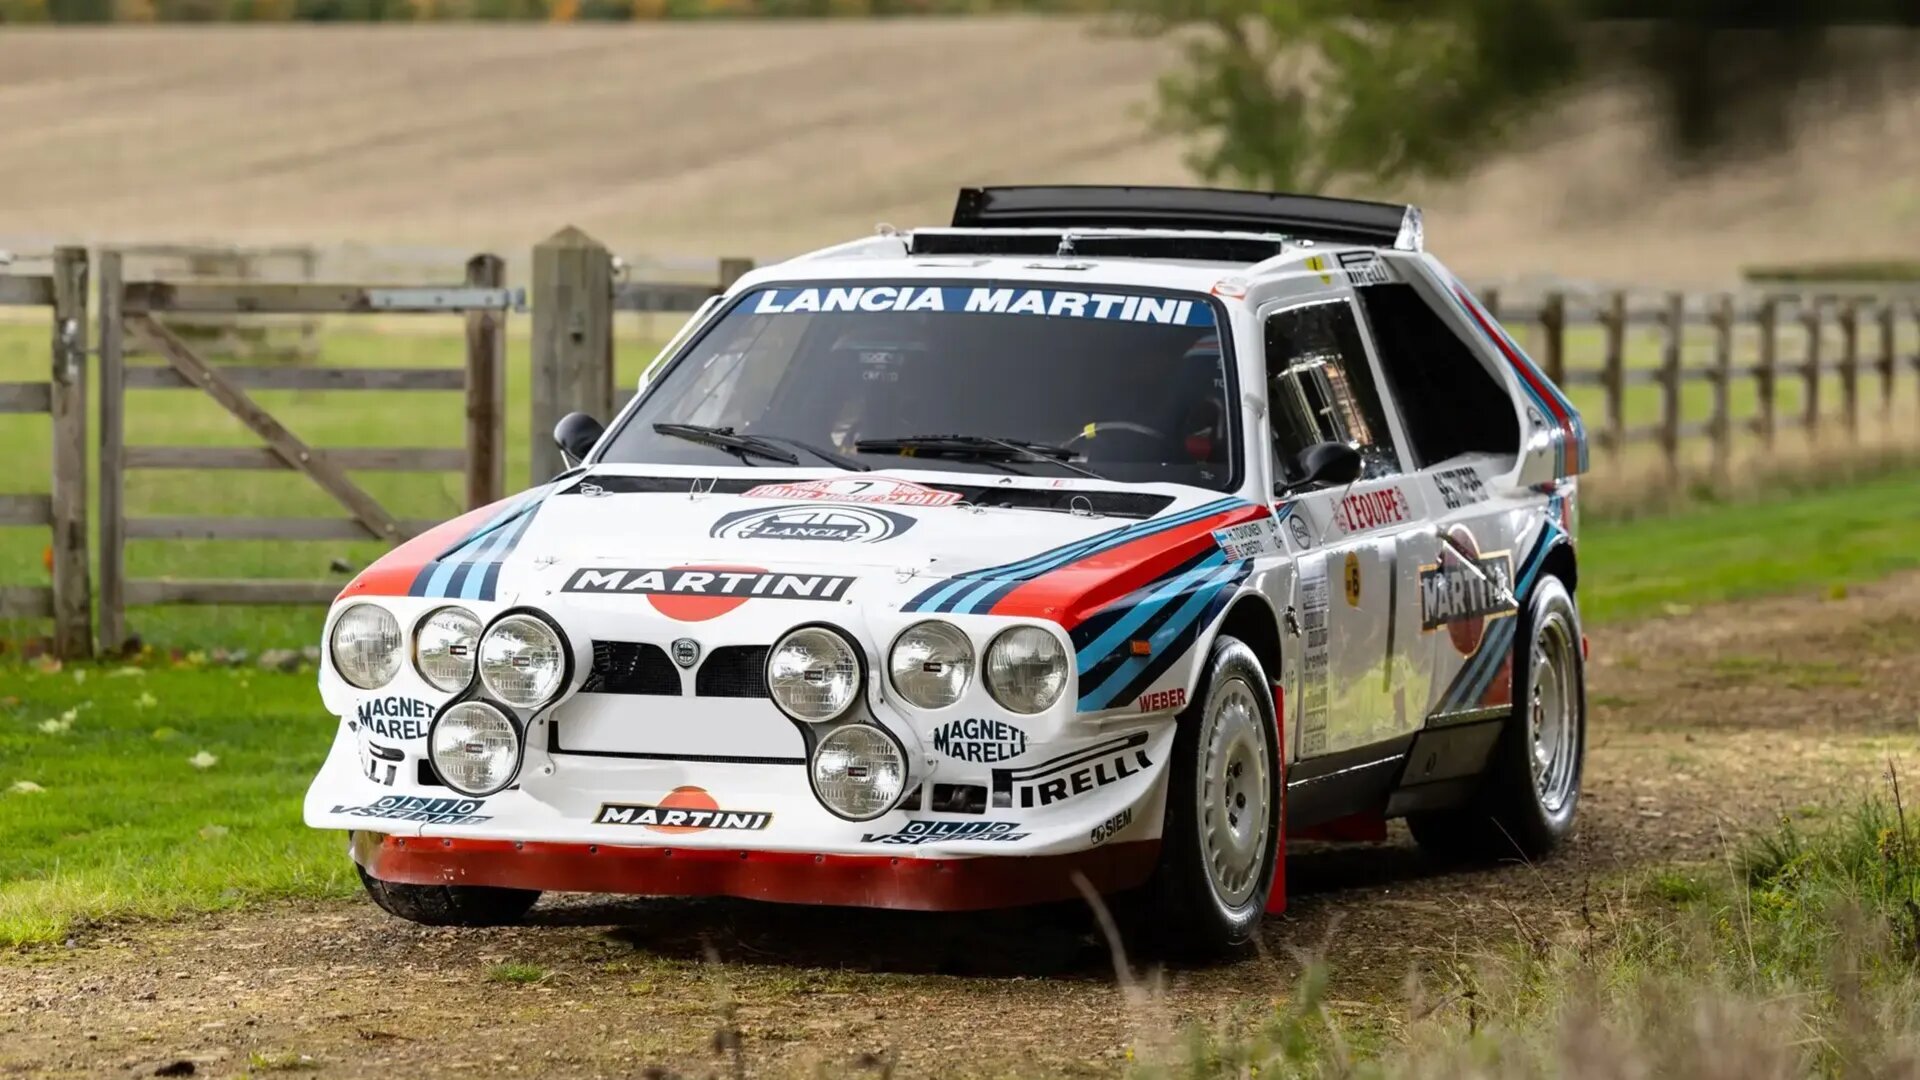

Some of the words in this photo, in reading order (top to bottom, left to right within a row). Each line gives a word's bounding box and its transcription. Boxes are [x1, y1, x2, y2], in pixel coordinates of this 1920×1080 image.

[754, 286, 944, 314] LANCIA
[964, 288, 1194, 326] MARTINI
[848, 481, 875, 495] 7
[1342, 488, 1403, 532] L'EQUIPE
[760, 526, 849, 538] LANCIA
[572, 570, 843, 598] MARTINI
[358, 696, 435, 726] MAGNET
[1139, 688, 1187, 713] WEBER
[933, 718, 1026, 756] MAGNETI
[933, 736, 1026, 763] MARELLI
[992, 731, 1154, 808] PIRELLI
[378, 797, 476, 814] OLIO
[600, 807, 766, 829] MARTINI
[907, 822, 1012, 835] OLIO
[1105, 808, 1132, 838] SIEM
